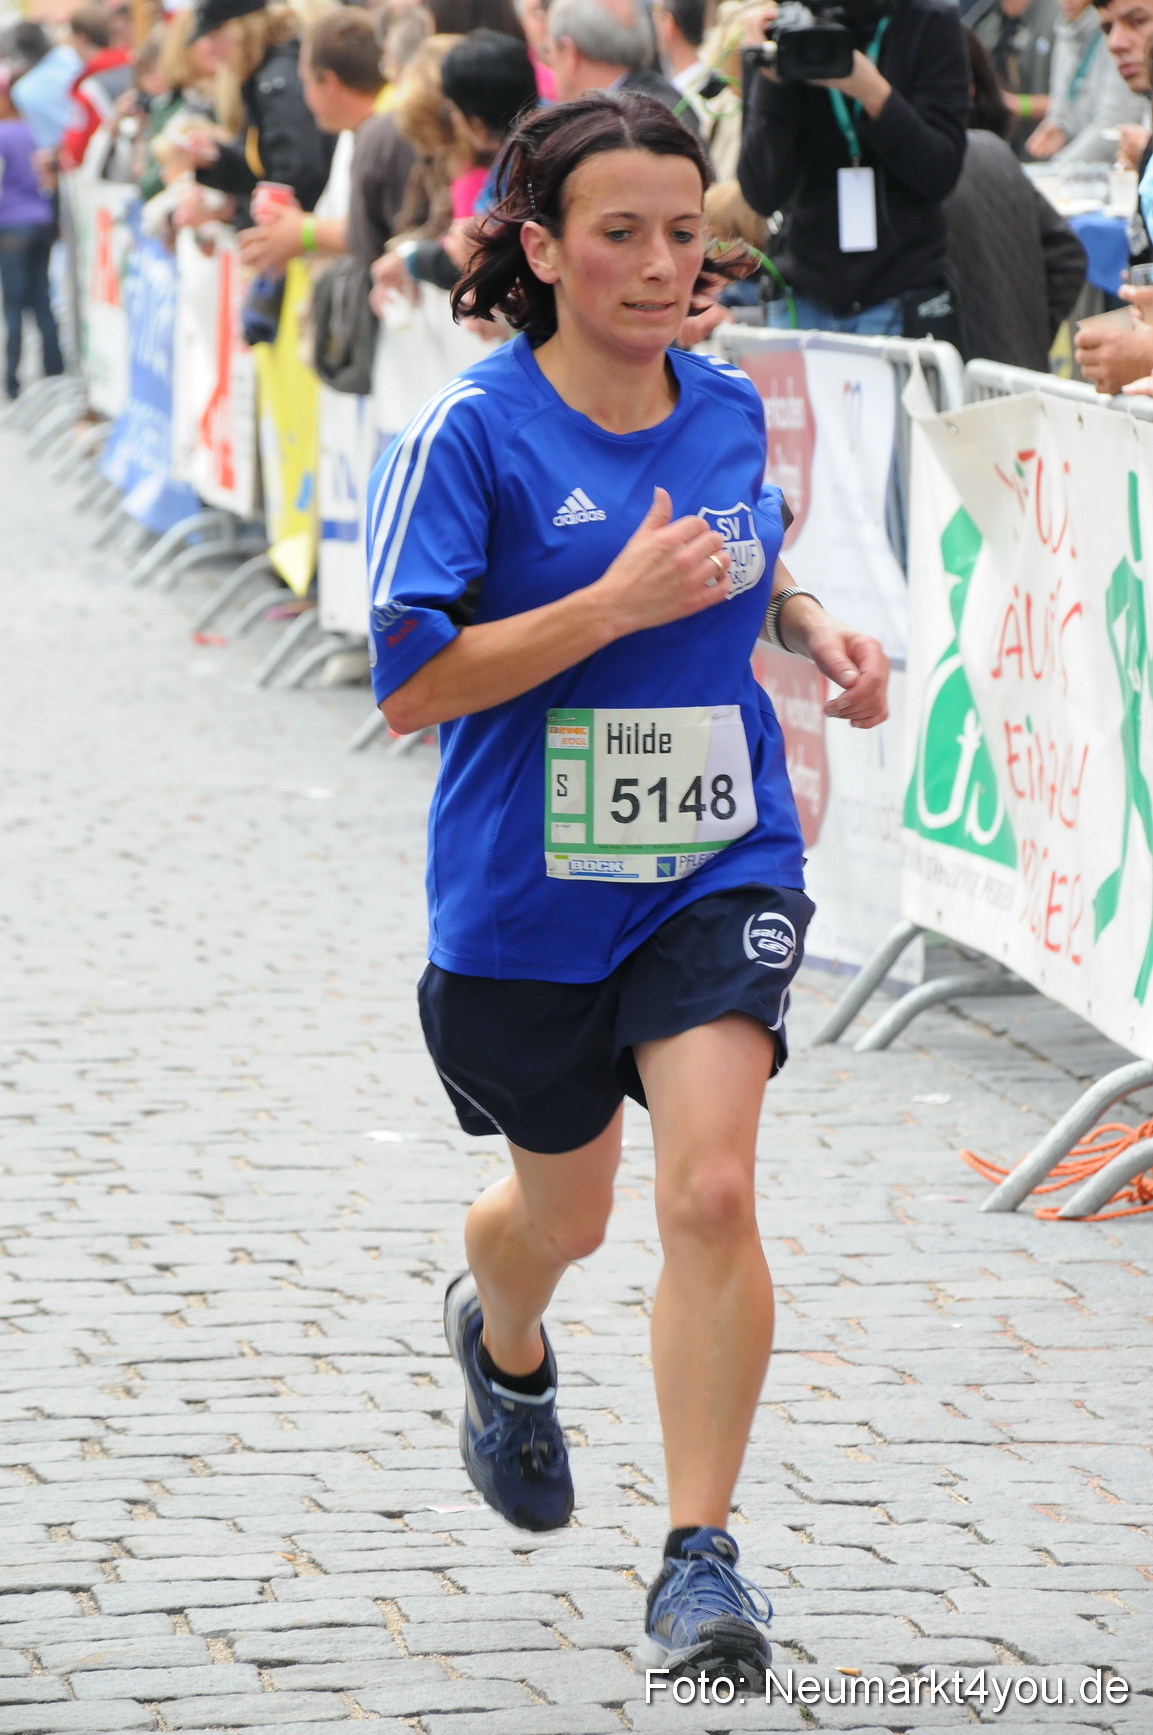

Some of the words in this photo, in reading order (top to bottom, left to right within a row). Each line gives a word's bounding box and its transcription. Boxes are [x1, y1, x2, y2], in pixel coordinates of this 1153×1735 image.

[552, 509, 607, 527] adidas
[716, 516, 740, 542] SV
[720, 543, 757, 567] AUF
[606, 721, 672, 756] Hilde
[556, 773, 568, 798] S
[609, 773, 737, 824] 5148
[568, 859, 625, 873] BOCK
